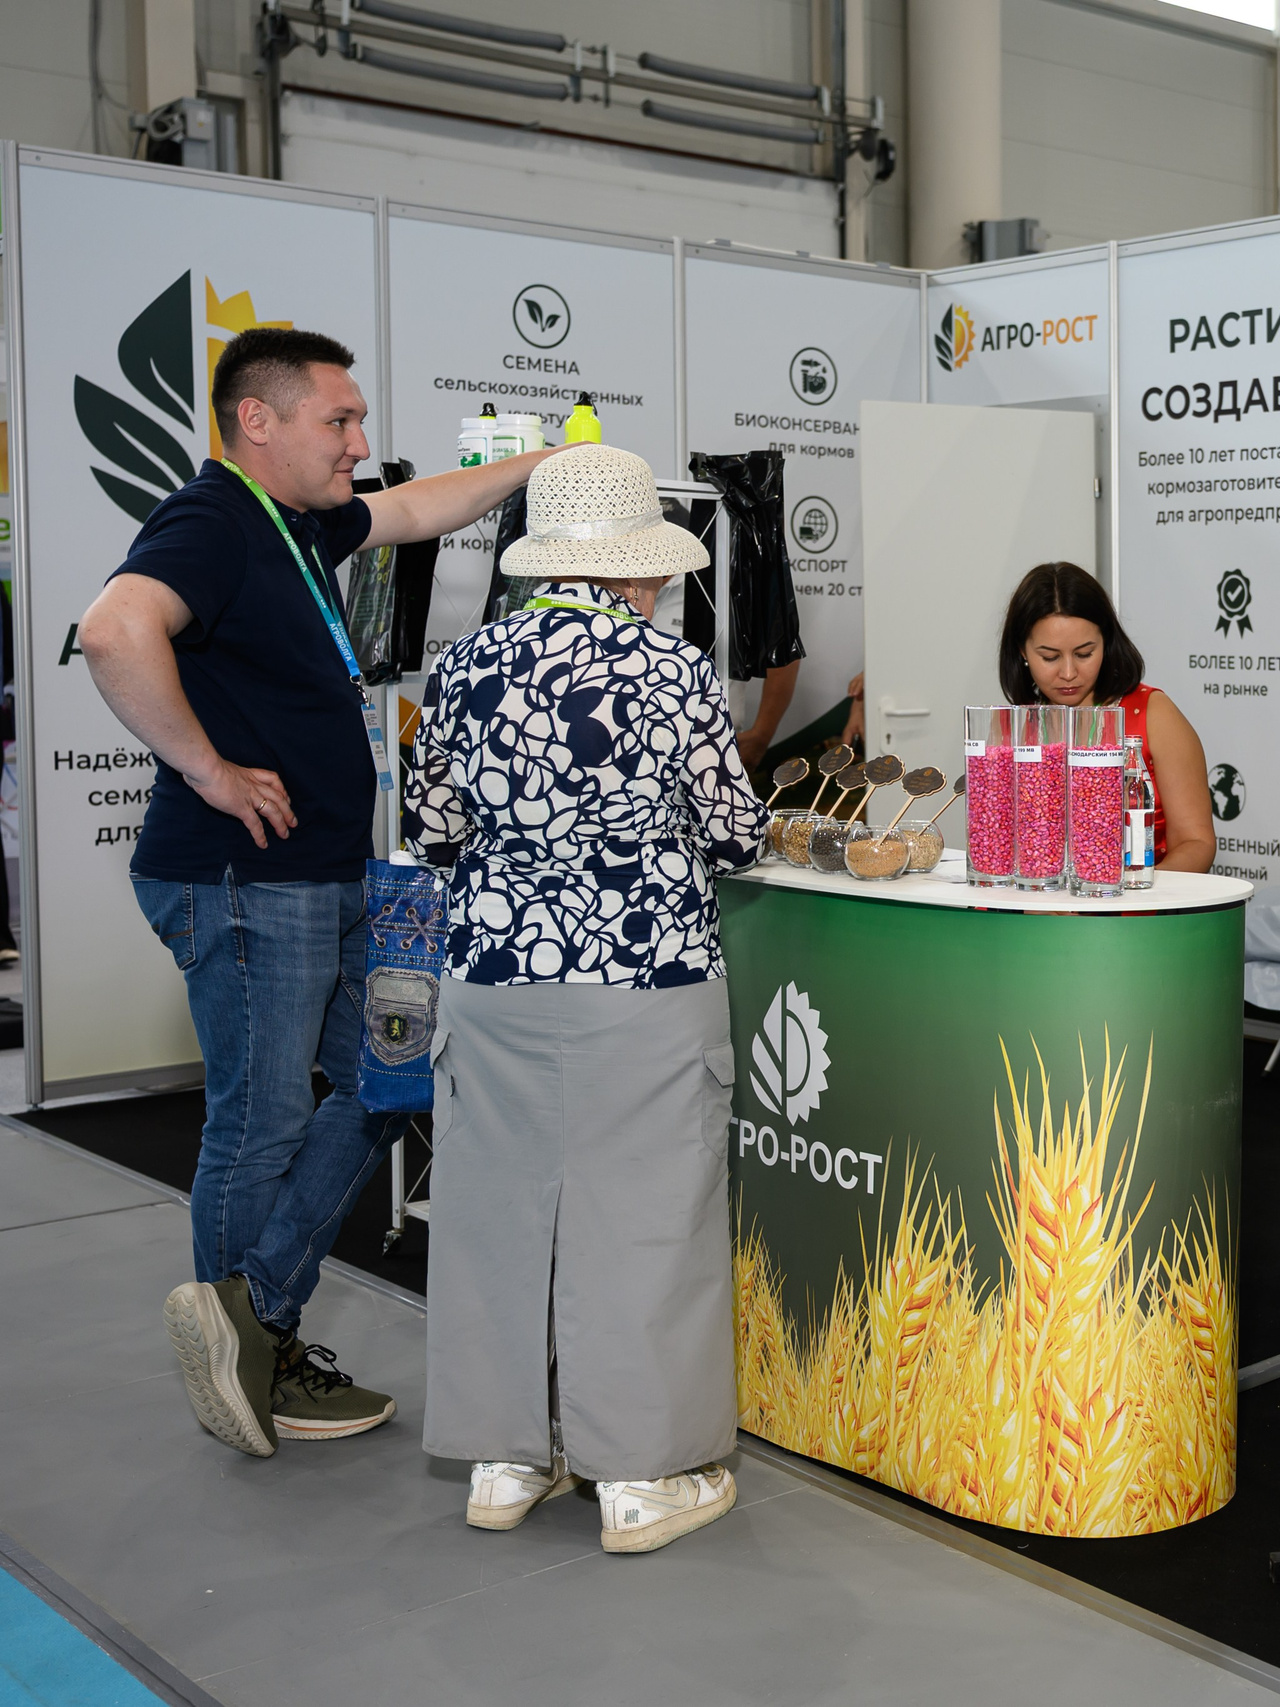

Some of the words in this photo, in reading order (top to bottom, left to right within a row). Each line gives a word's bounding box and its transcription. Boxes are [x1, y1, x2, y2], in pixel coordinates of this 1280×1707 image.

[981, 314, 1098, 353] АГРО-РОСТ
[503, 354, 580, 376] СЕМЕНА
[434, 377, 643, 406] сельскохозяйстенных
[799, 444, 855, 460] кормов
[1138, 450, 1185, 468] Более
[1188, 447, 1205, 465] 10
[1208, 449, 1236, 464] лет
[1155, 509, 1184, 526] для
[283, 532, 308, 573] АГРОВОЛГА
[788, 558, 848, 573] КСПОРТ
[795, 584, 824, 596] чем
[827, 582, 845, 597] 20
[329, 622, 353, 662] АГРОВОЛГА
[1188, 654, 1236, 670] БОЛЕЕ
[1238, 655, 1253, 671] 10
[1203, 683, 1220, 695] на
[1223, 683, 1268, 698] рынке
[54, 747, 153, 773] Надёж
[730, 1116, 883, 1195] РО-РОСТ
